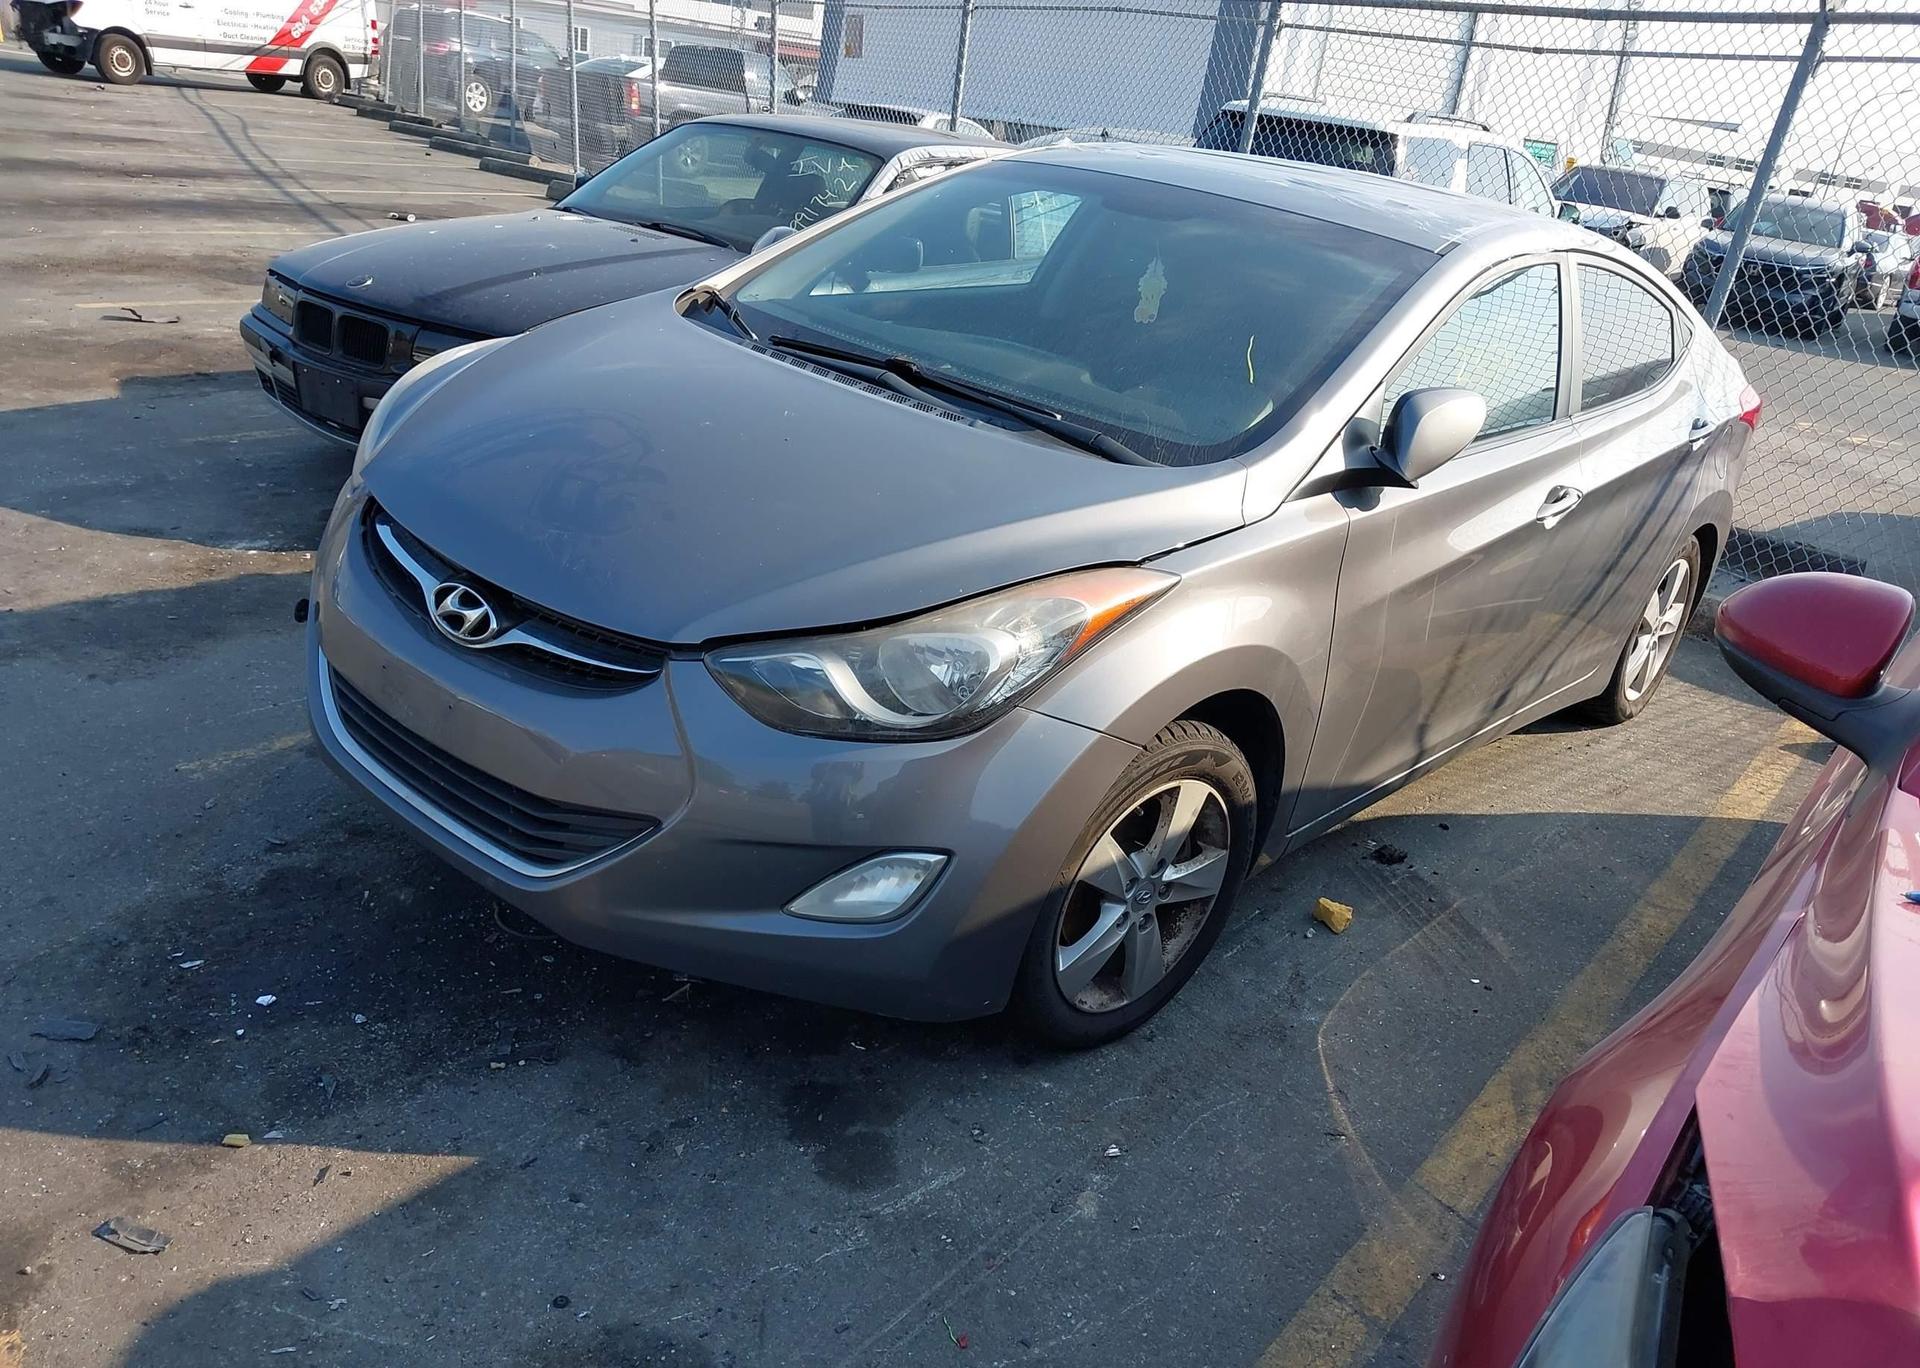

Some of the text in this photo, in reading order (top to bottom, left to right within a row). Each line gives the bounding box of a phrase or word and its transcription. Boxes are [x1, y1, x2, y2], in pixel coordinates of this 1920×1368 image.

[144, 8, 171, 17] Service
[223, 7, 285, 23] Cooling Plumbing
[216, 18, 279, 34] Electrical Heating
[291, 14, 311, 38] 604
[222, 31, 268, 44] Duct Cleaning
